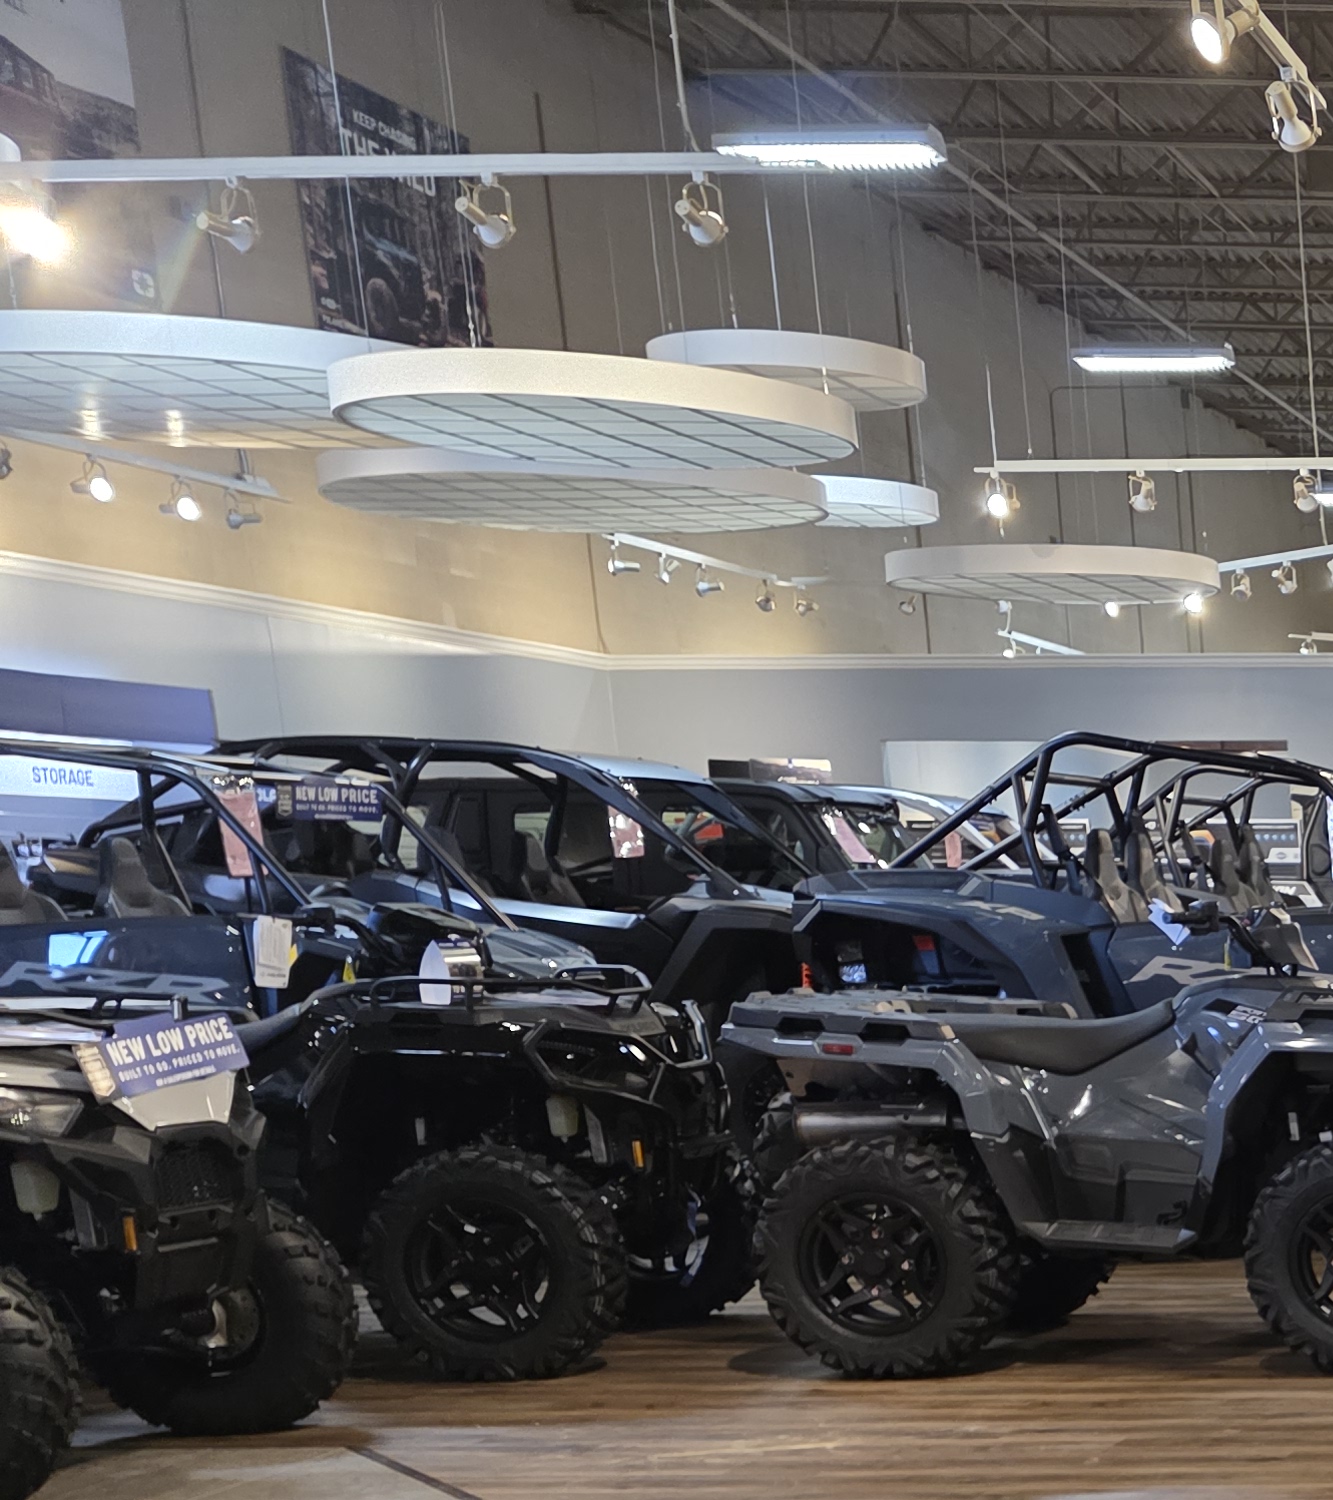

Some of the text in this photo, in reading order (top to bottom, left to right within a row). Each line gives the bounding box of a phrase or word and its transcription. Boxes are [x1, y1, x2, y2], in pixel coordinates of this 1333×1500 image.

[353, 108, 378, 130] KEEP
[32, 765, 94, 788] STORAGE
[295, 786, 316, 801] NEW
[318, 787, 338, 802] LOW
[341, 788, 379, 804] PRICE
[106, 1016, 234, 1067] NEW LOW PRICE
